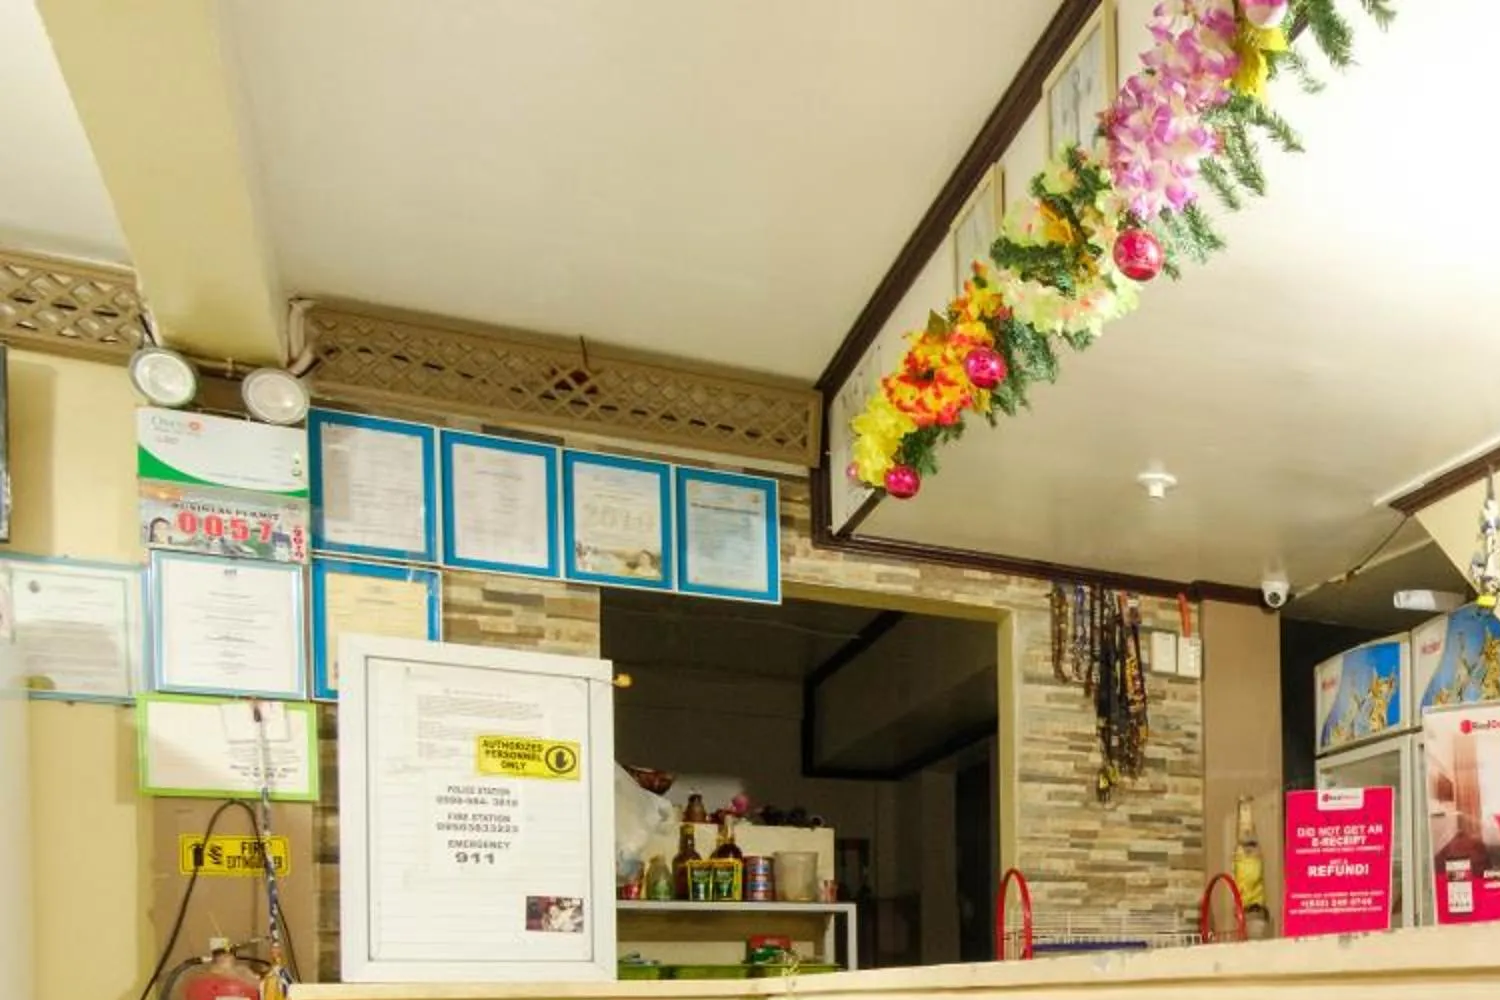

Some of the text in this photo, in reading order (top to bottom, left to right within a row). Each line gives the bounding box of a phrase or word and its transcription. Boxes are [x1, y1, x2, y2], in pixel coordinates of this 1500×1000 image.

[177, 511, 274, 544] 0057
[500, 760, 527, 770] ONLY
[471, 813, 511, 822] STATION
[447, 839, 511, 849] EMERGENCY
[455, 851, 495, 864] 911
[1308, 864, 1369, 877] REFUND!
